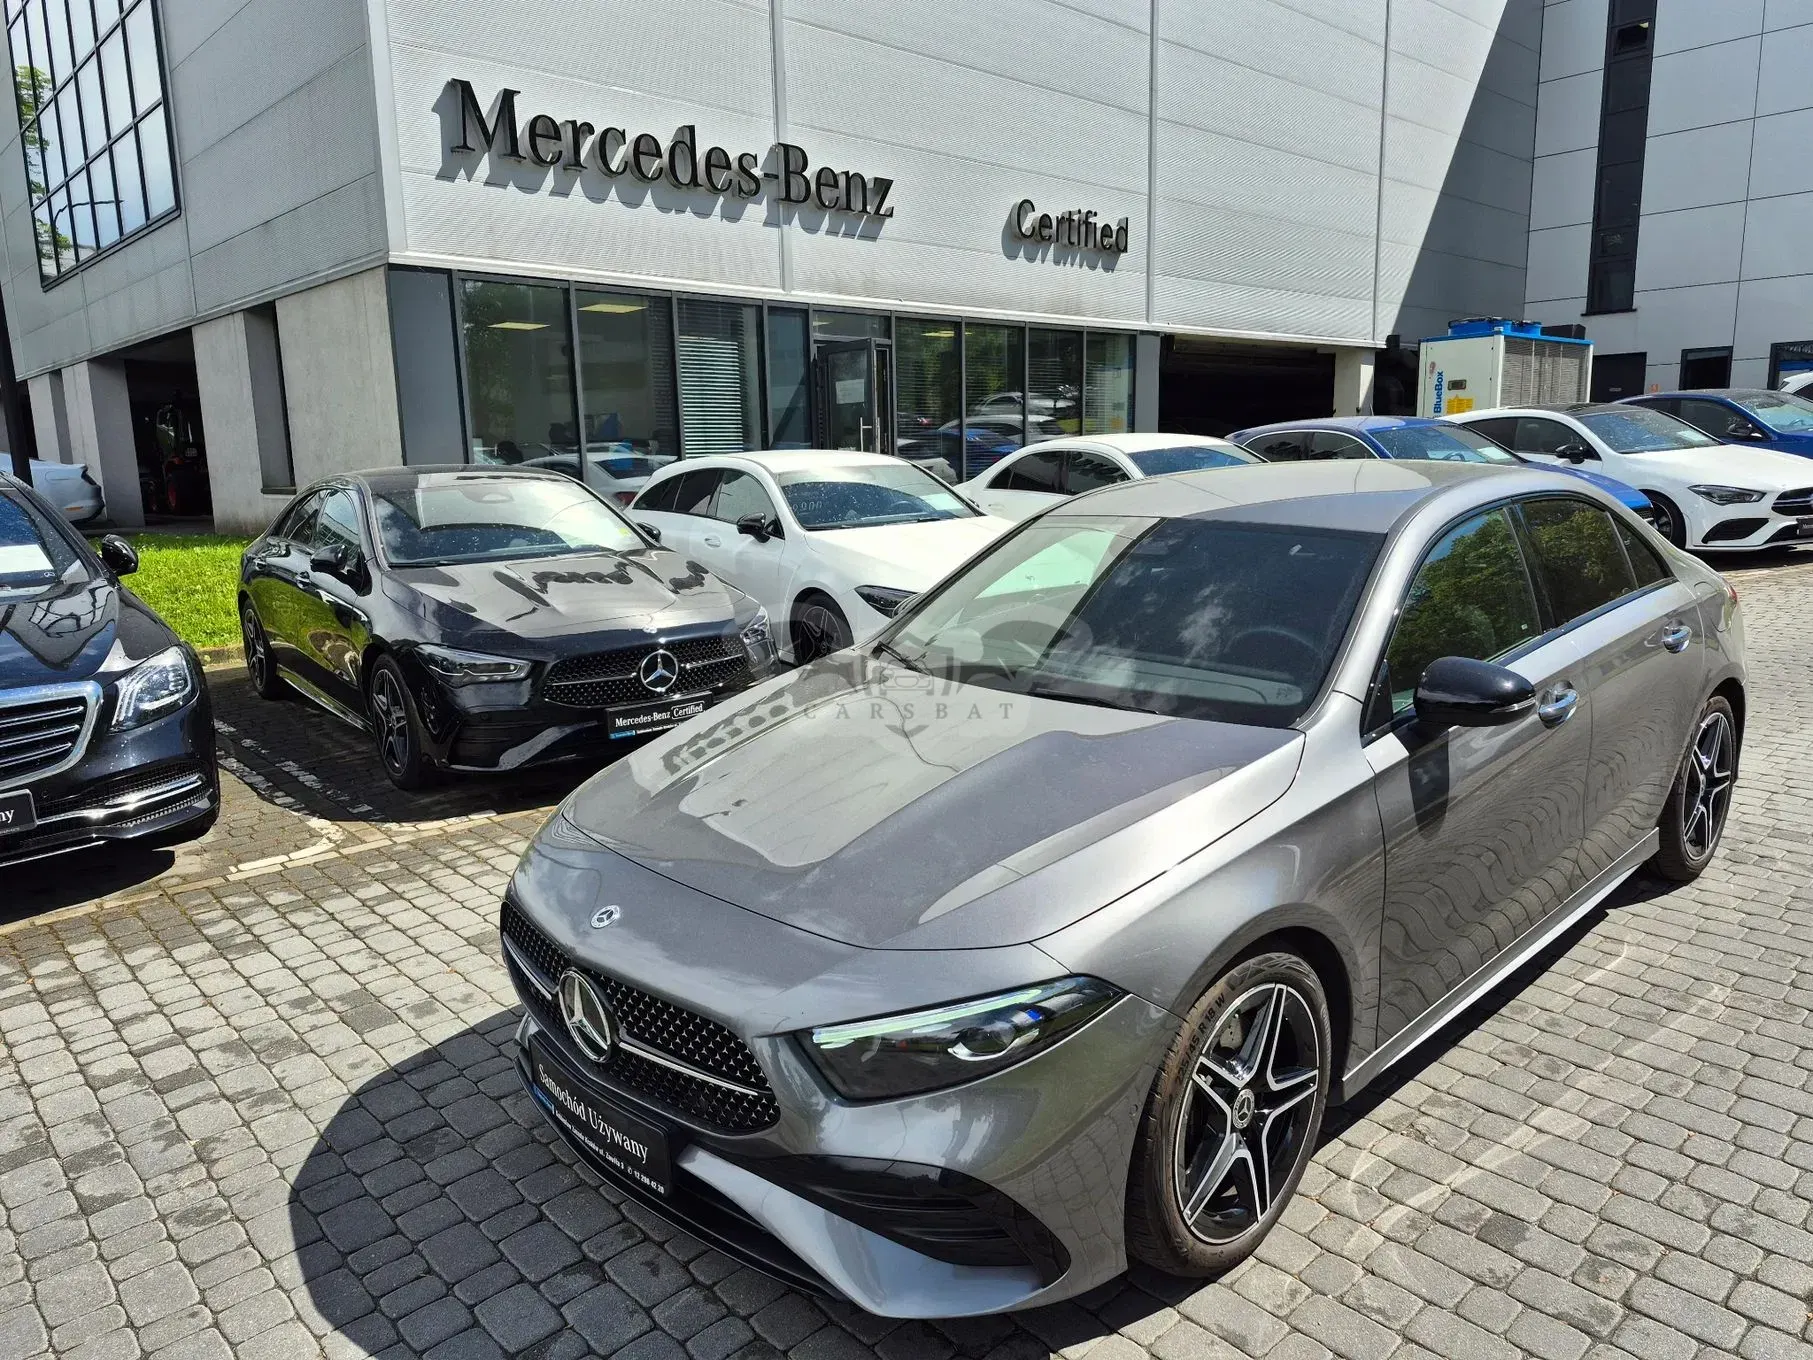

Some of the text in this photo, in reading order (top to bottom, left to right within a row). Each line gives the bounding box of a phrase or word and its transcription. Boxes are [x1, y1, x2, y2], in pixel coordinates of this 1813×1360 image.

[450, 77, 895, 219] Mercedes-Benz
[1014, 198, 1129, 253] Certified
[1433, 370, 1444, 413] BlueBox
[615, 703, 703, 728] Mercedes-Benz Certified
[538, 1063, 588, 1122] Samochód
[587, 1106, 649, 1164] Używany
